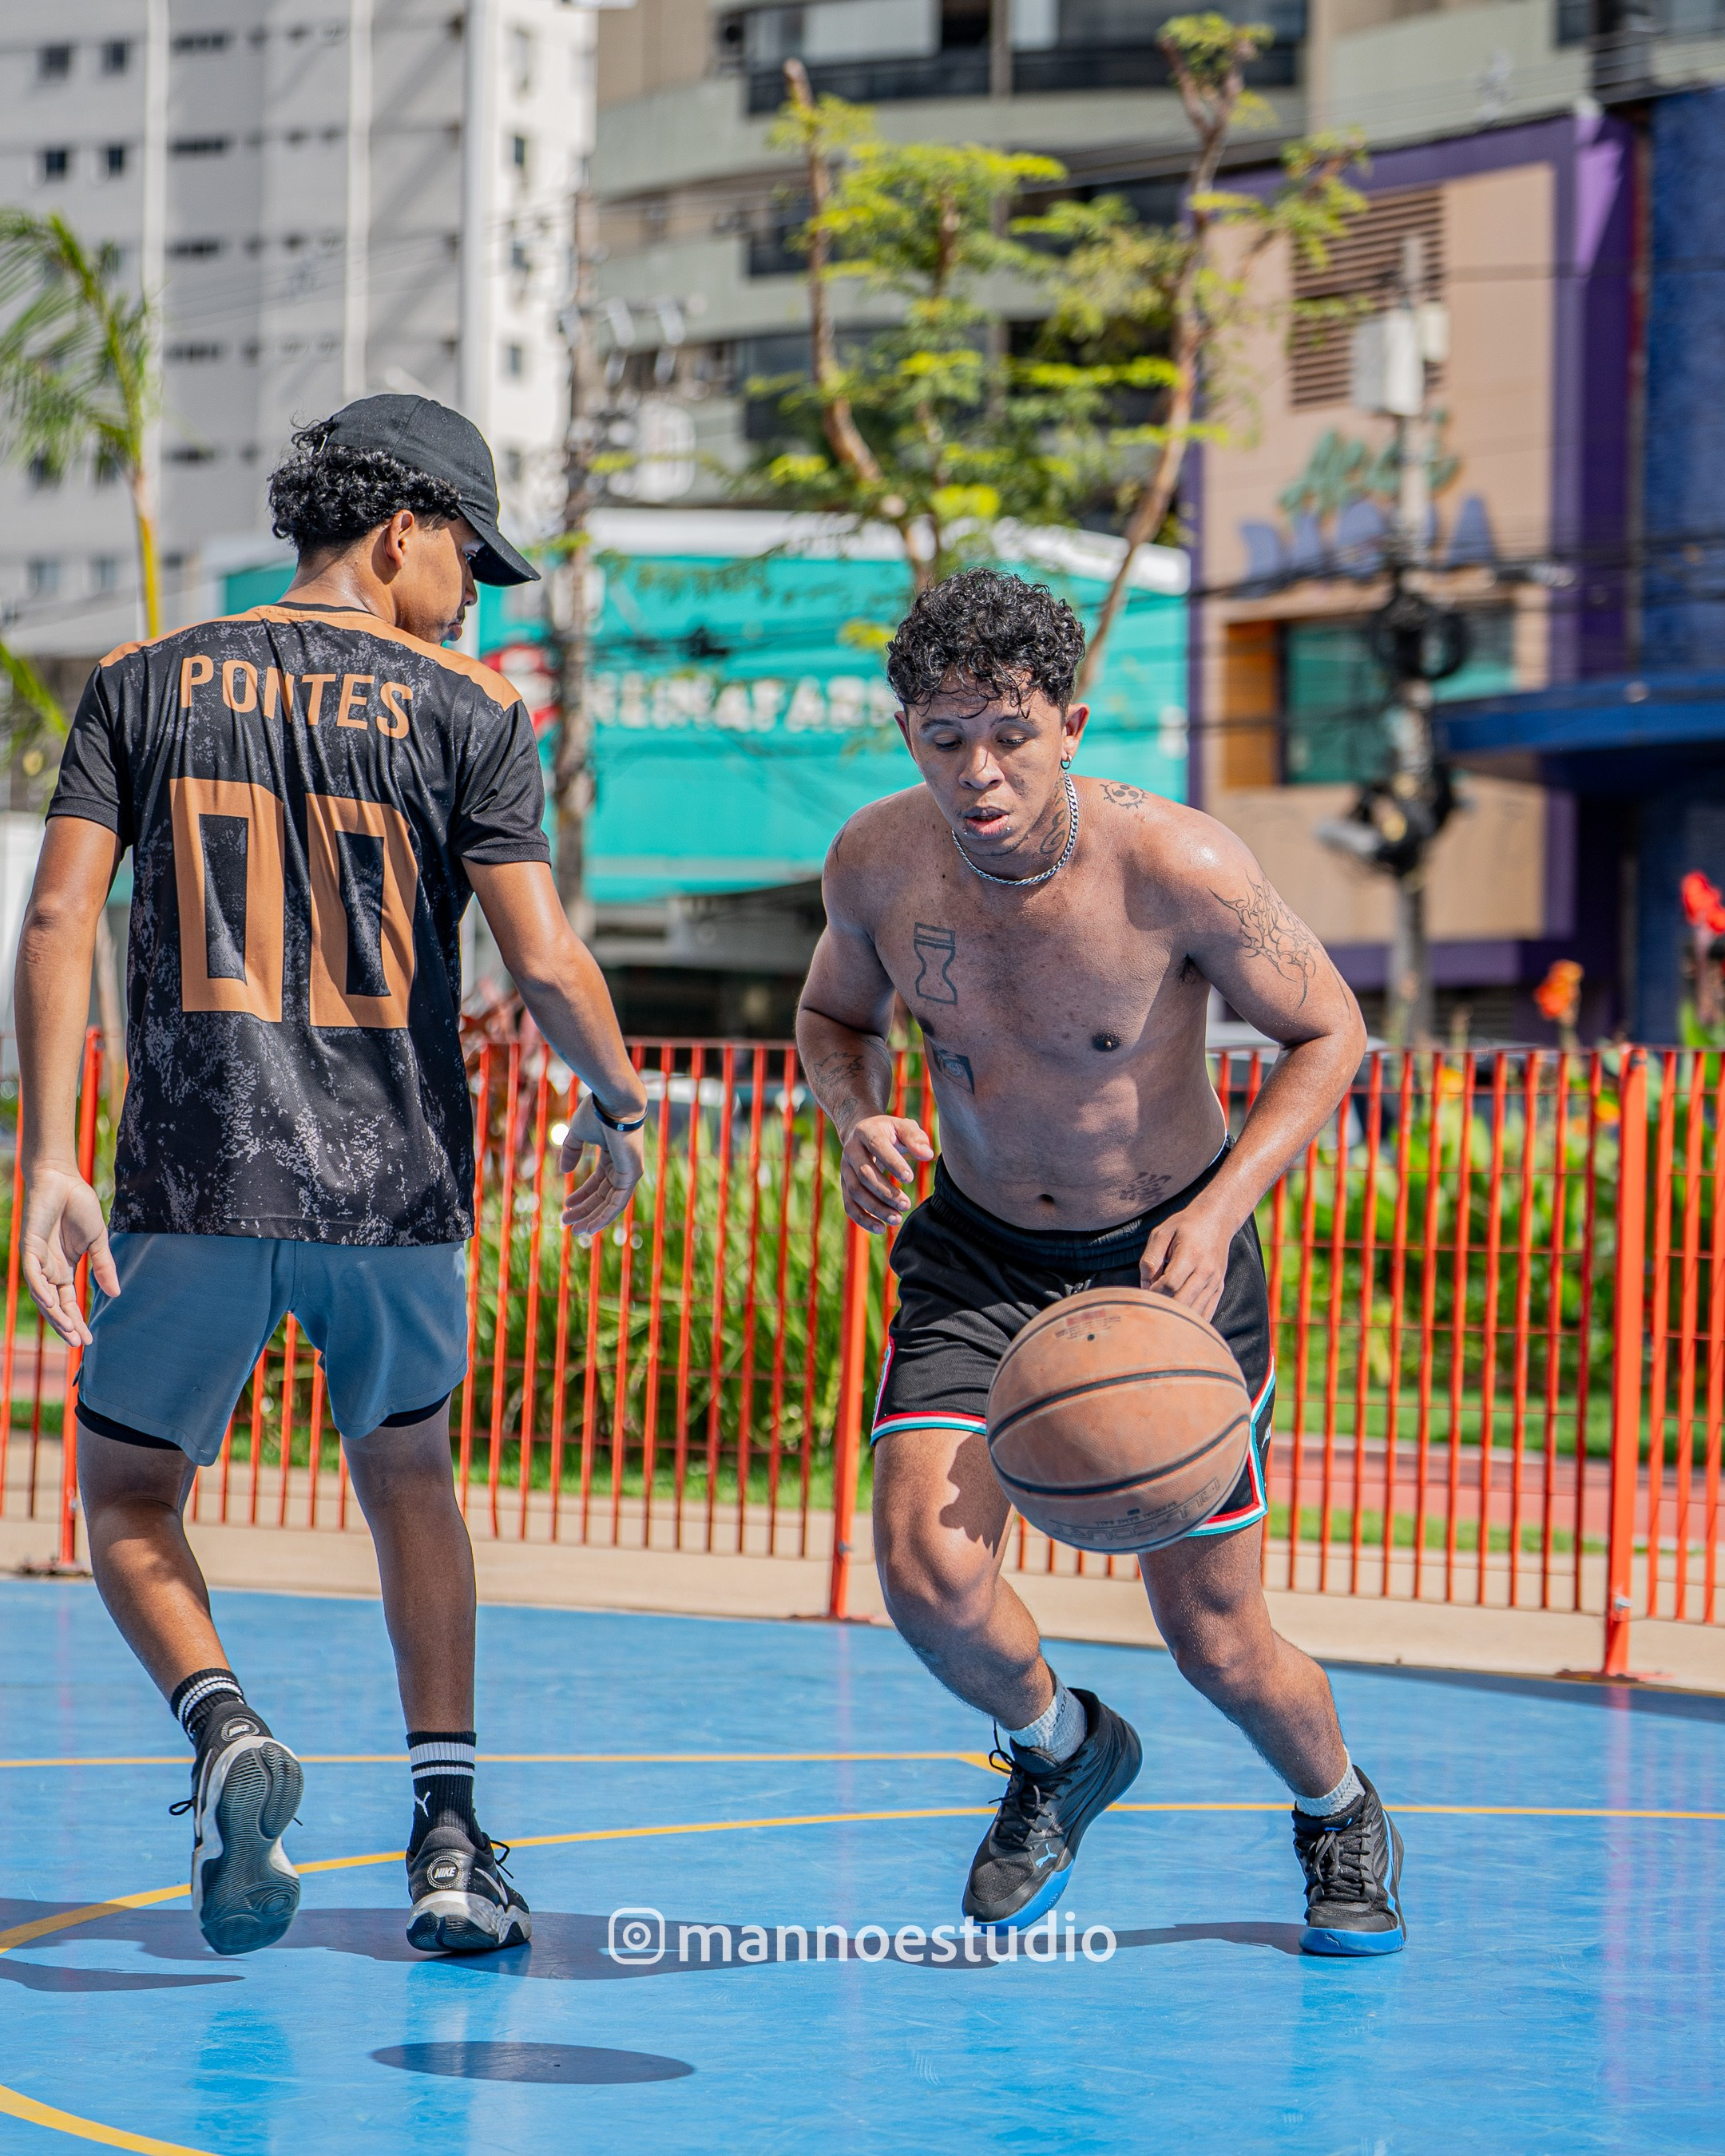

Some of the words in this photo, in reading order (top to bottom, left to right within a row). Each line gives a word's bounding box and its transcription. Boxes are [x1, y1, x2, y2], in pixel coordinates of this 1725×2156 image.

[180, 655, 414, 739] PONTES
[169, 776, 418, 1029] 00
[434, 1866, 457, 1879] NIKE
